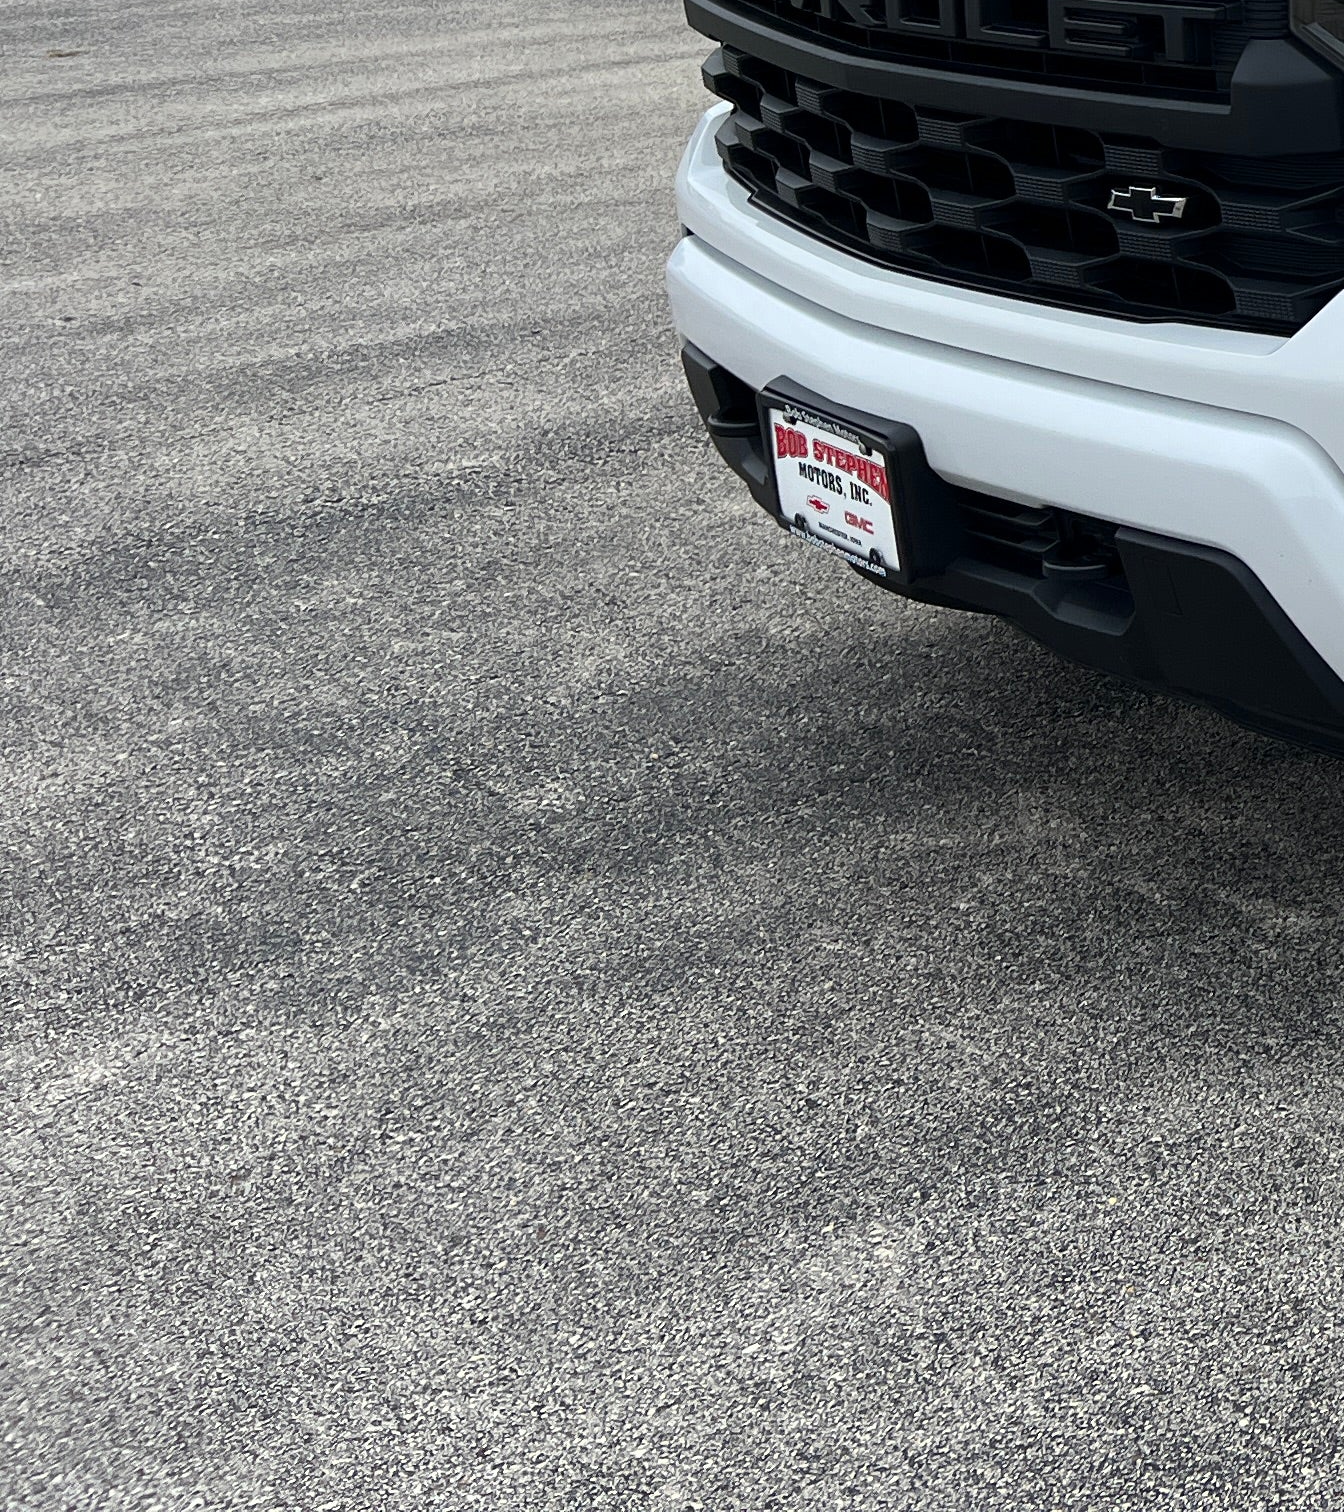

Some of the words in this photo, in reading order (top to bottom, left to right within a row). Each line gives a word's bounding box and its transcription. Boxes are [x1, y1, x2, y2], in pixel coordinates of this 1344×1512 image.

[774, 422, 808, 458] BOB
[812, 439, 891, 505] STEPHEN
[798, 461, 847, 500] MOTORS,
[850, 481, 872, 506] INC.
[844, 510, 875, 535] GMC
